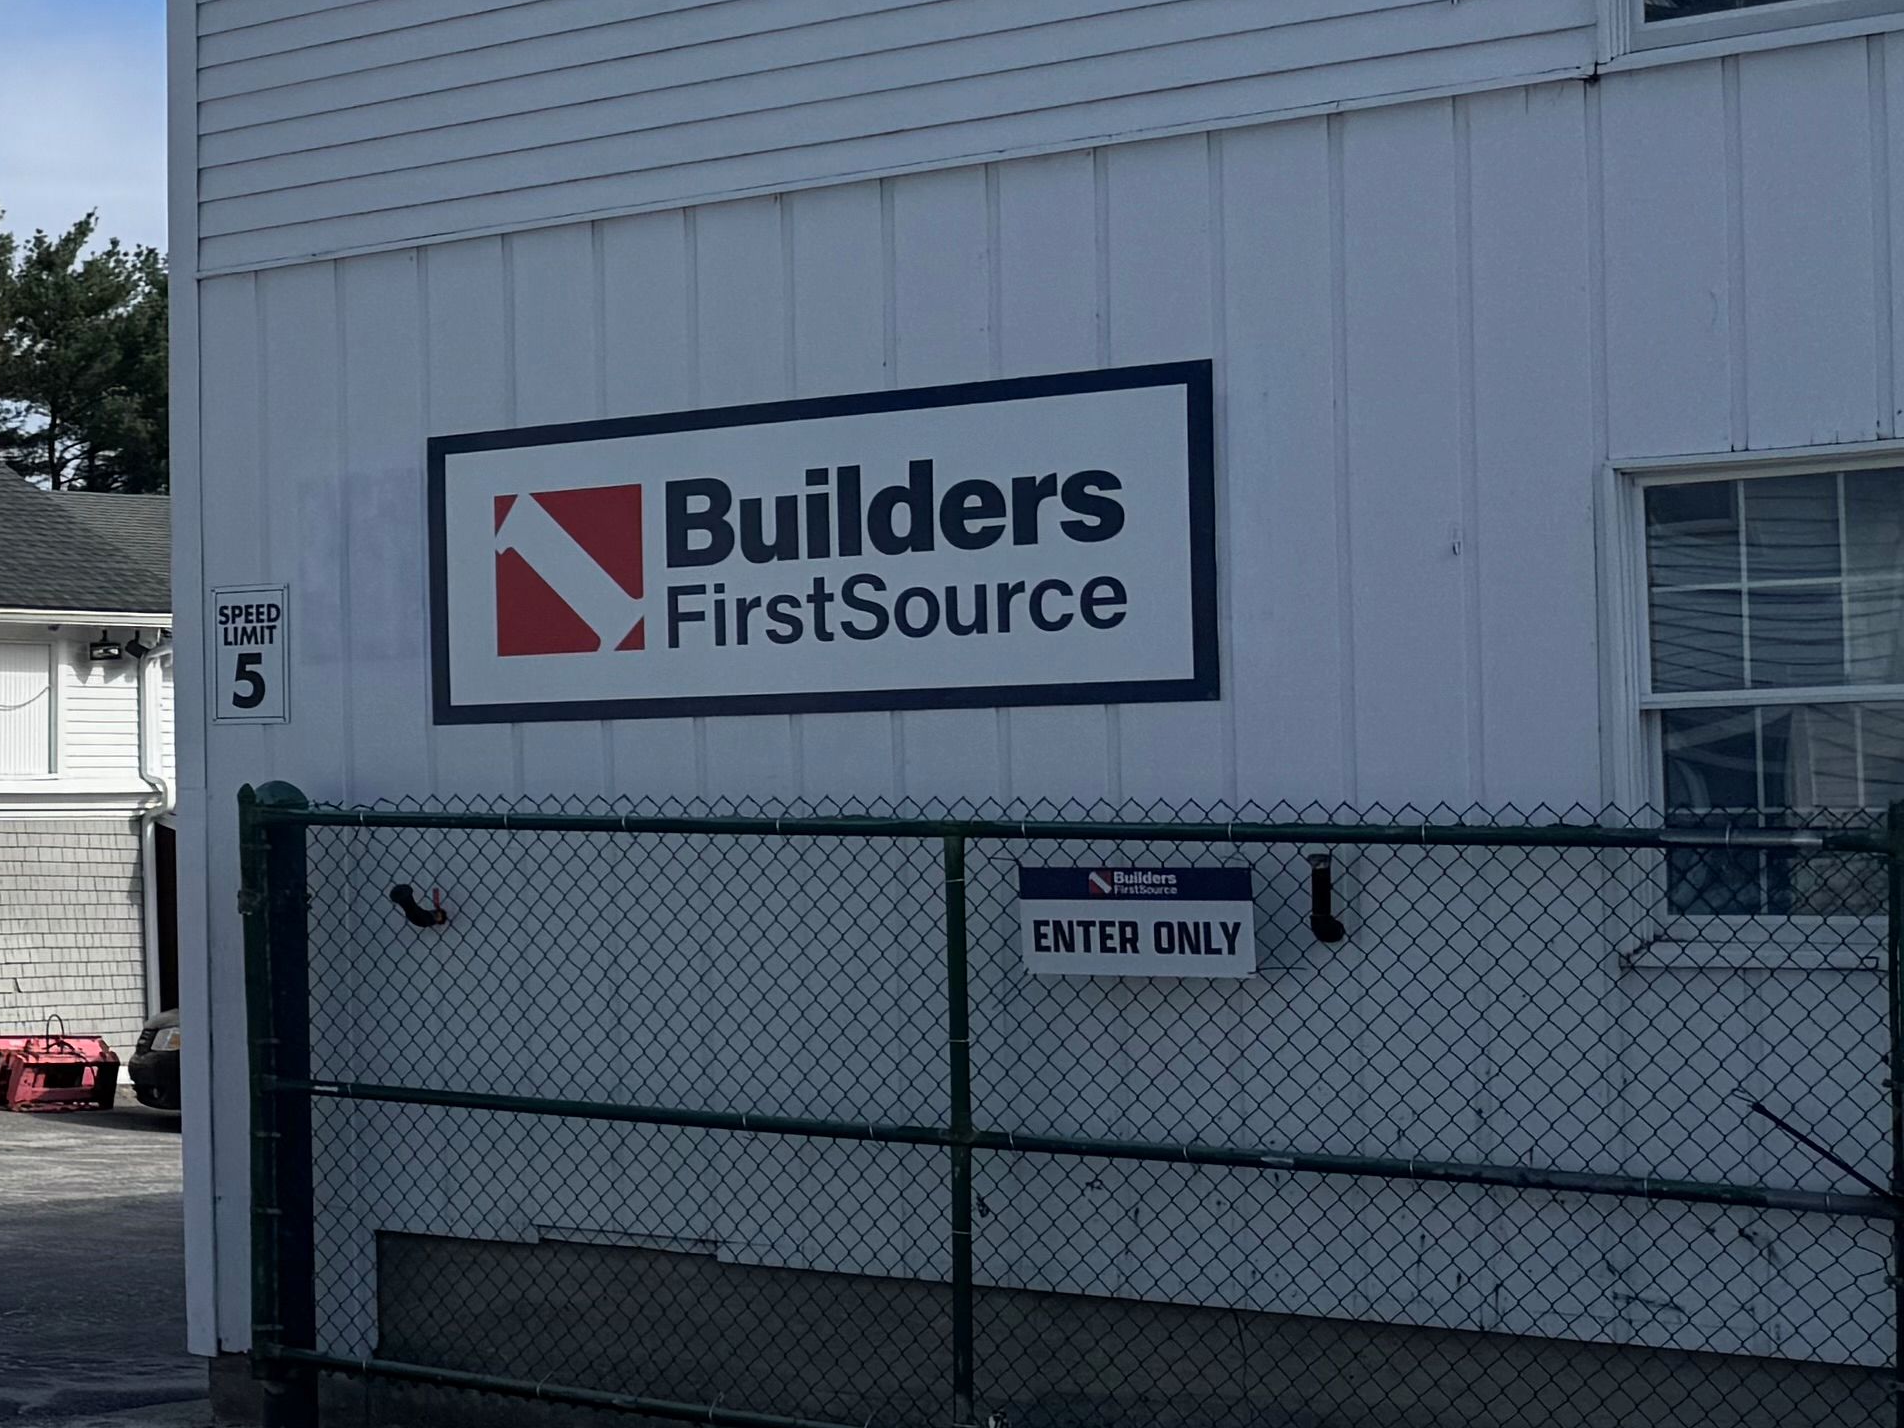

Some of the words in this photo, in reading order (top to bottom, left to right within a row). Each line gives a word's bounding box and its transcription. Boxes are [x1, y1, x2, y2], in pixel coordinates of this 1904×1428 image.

[665, 458, 1126, 569] Builders
[218, 603, 281, 625] SPEED
[666, 573, 1128, 649] FirstSource
[223, 625, 277, 646] LIMIT
[232, 652, 266, 709] 5
[1113, 871, 1177, 884] Builders
[1113, 884, 1178, 895] FirstSource
[1032, 919, 1141, 955] ENTER
[1153, 920, 1242, 956] ONLY
